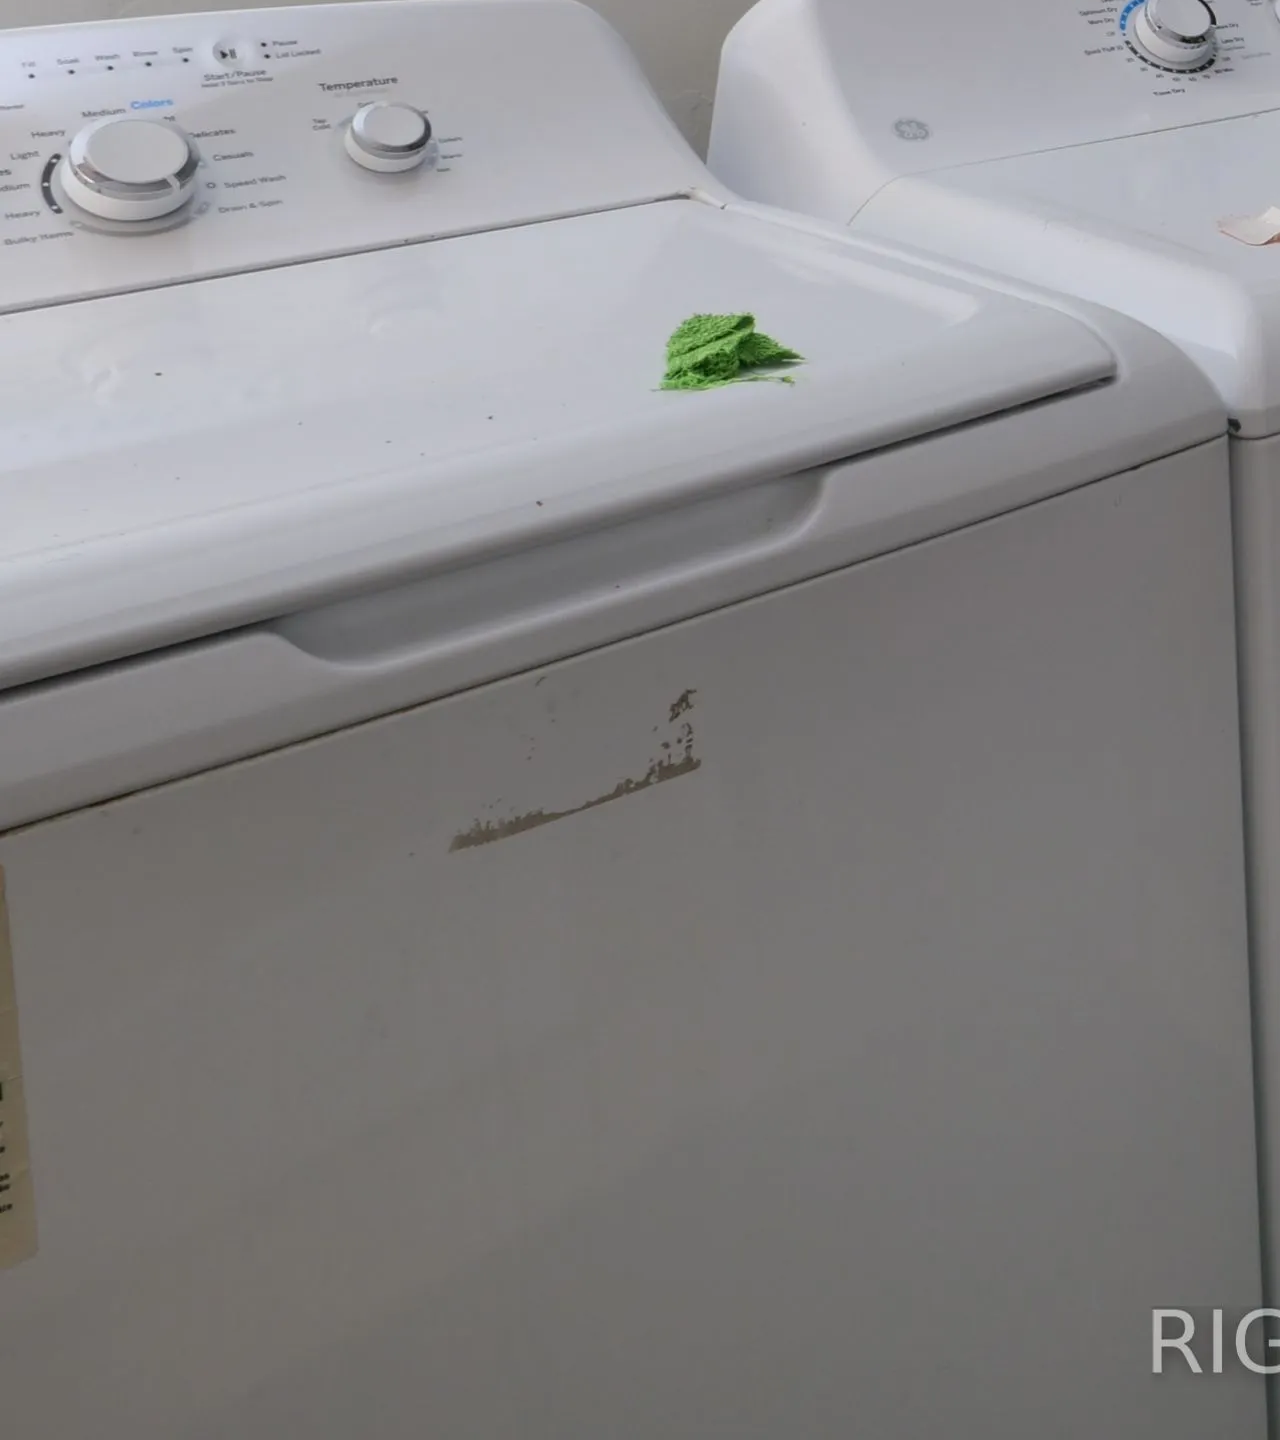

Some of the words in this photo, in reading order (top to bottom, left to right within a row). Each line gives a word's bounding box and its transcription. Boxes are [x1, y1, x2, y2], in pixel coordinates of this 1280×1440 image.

[203, 68, 267, 82] Start/Pause
[319, 76, 399, 92] Temperature
[130, 97, 174, 110] Colors
[81, 107, 126, 119] Medium
[31, 129, 66, 139] Heavy
[10, 150, 41, 162] Light
[212, 150, 255, 162] Casuals
[0, 182, 31, 193] dium
[223, 179, 256, 191] Speed
[257, 174, 287, 184] Wash
[258, 199, 284, 211] Spin
[5, 208, 41, 220] Heavy
[4, 234, 38, 246] Bulky
[40, 229, 74, 241] Items
